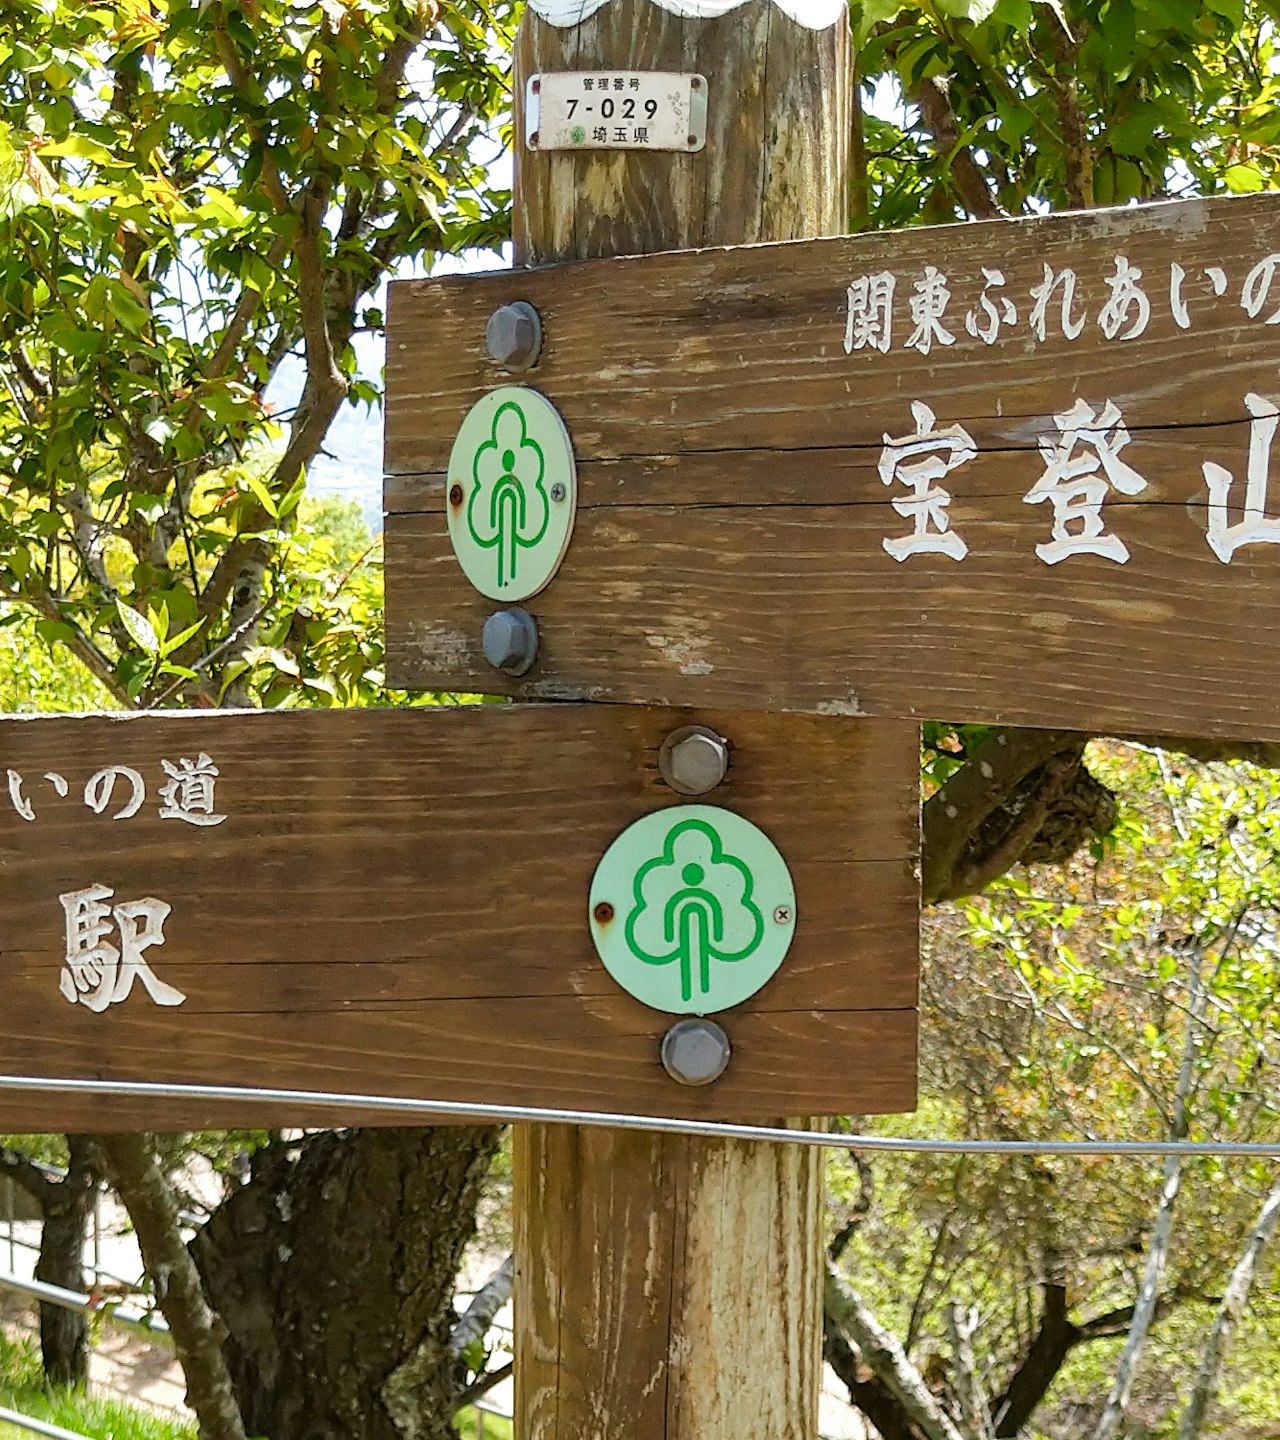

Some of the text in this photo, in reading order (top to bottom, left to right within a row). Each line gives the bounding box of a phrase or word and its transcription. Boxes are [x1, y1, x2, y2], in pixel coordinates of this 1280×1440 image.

[583, 78, 641, 92] 管理番号
[566, 98, 658, 120] 7-029
[592, 126, 650, 143] 埼玉県
